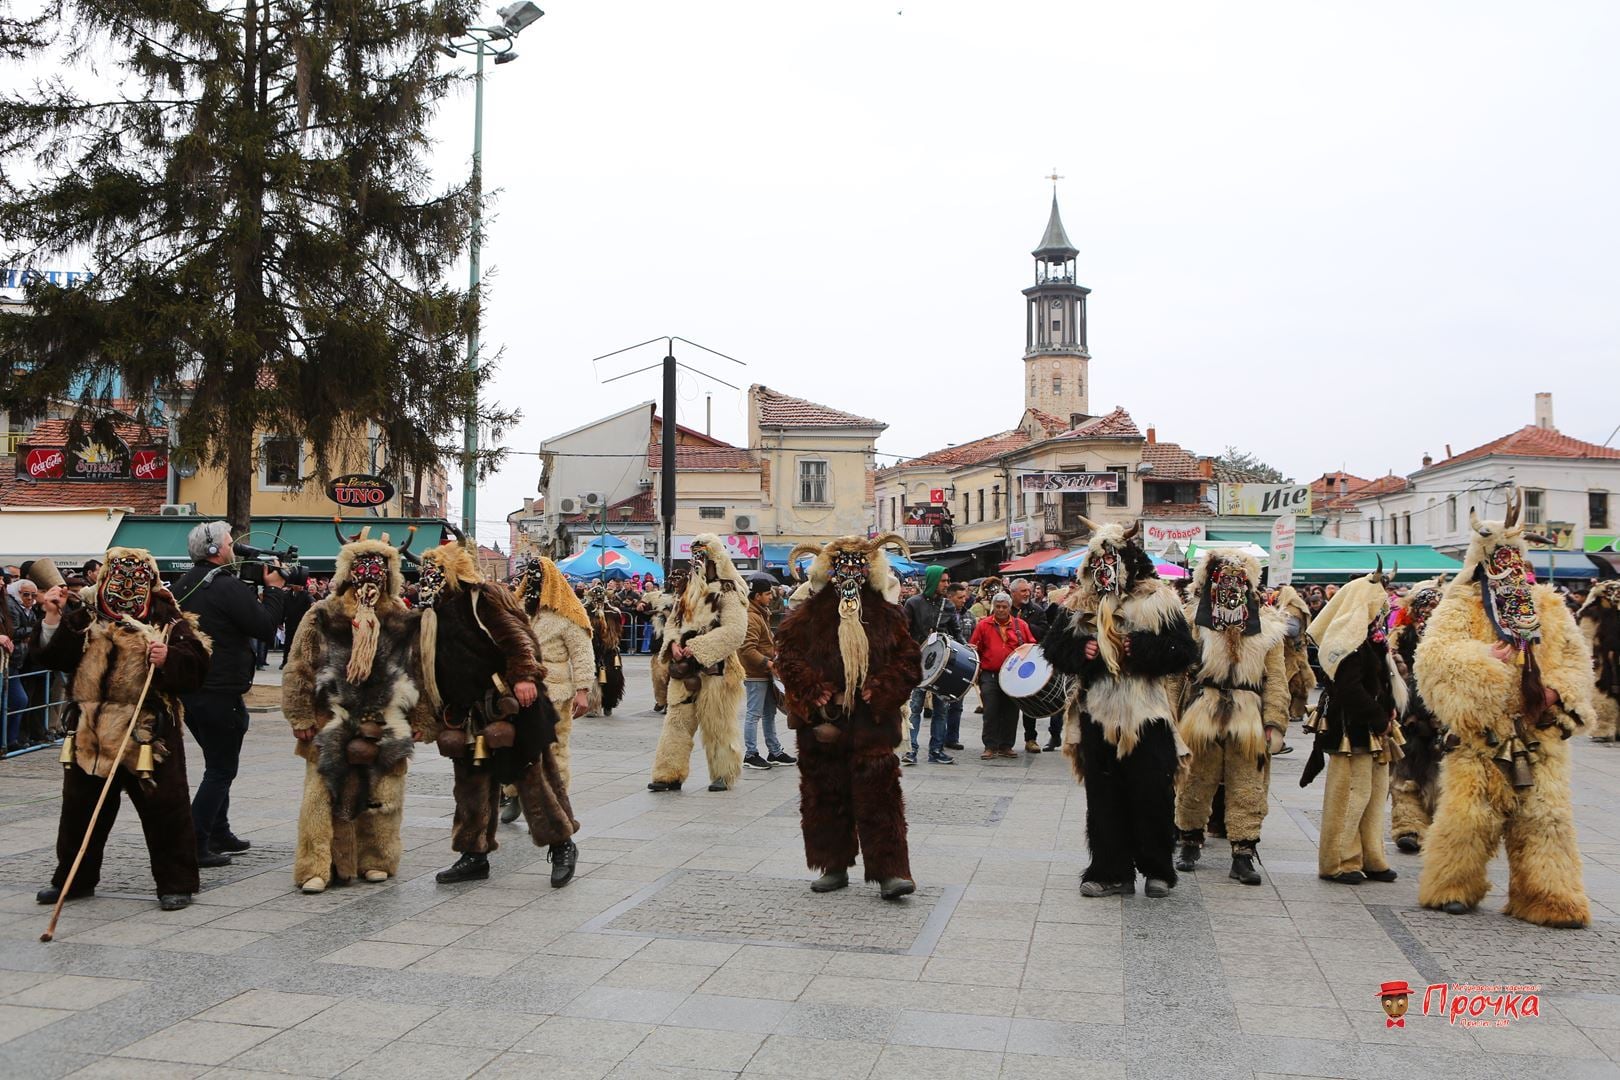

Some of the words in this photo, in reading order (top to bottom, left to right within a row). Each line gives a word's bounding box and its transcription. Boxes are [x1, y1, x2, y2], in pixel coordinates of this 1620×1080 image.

[1045, 474, 1096, 491] Stil
[335, 488, 384, 503] UNO
[1148, 526, 1166, 541] City
[1167, 526, 1201, 540] Tobacco
